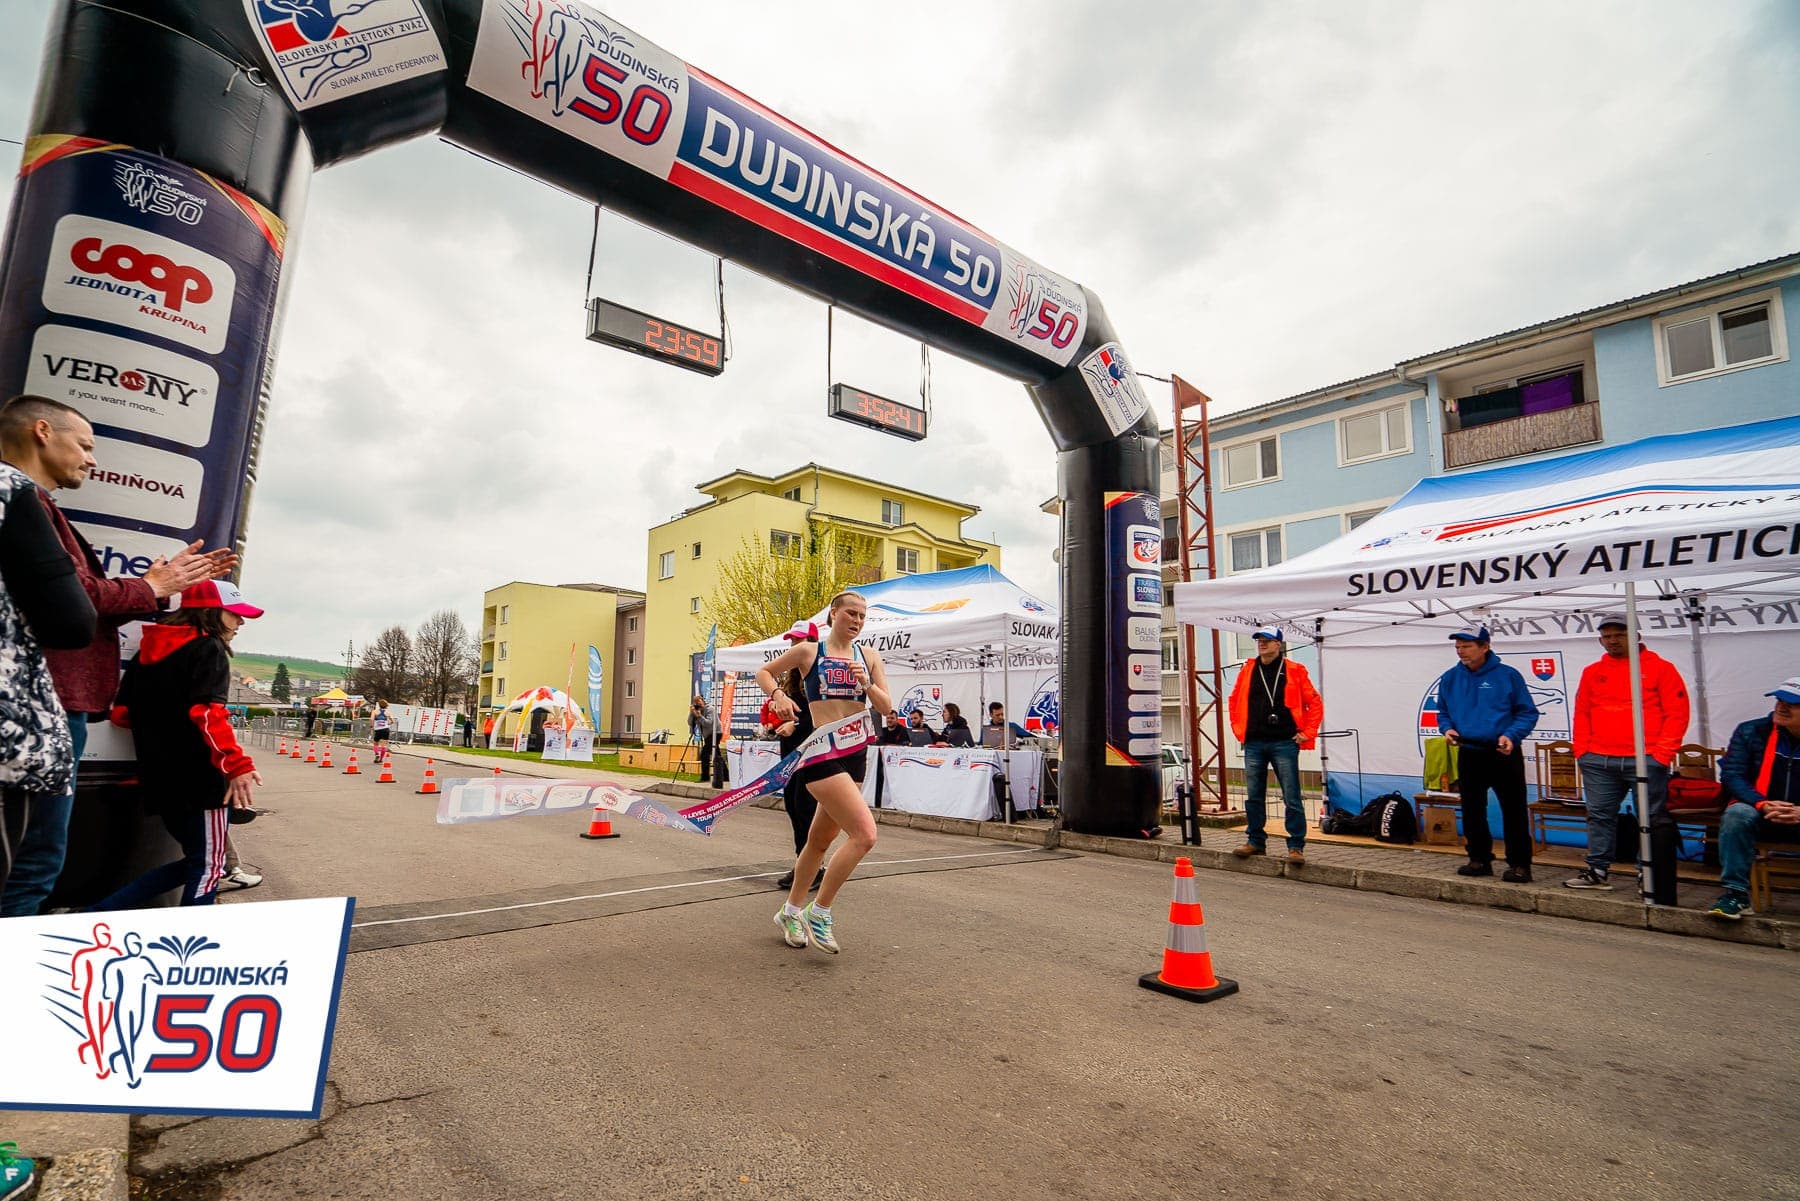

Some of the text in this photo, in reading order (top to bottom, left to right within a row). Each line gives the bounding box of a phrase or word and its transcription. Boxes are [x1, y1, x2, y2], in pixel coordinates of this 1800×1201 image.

[330, 53, 440, 90] SLOVAK ATHLETIC FEDERATION
[597, 40, 679, 94] DUDINSKÁ
[567, 53, 672, 146] 50
[147, 189, 204, 225] 50
[699, 106, 996, 298] DUDINSKÁ 50
[64, 275, 158, 304] JEDNOTA
[138, 305, 207, 334] KRUPINA
[1026, 298, 1079, 349] 50
[644, 319, 719, 366] 23:59
[68, 388, 76, 396] if
[77, 391, 98, 402] you
[100, 394, 126, 407] want
[856, 393, 923, 433] 3:52:41
[89, 468, 185, 499] HRIŇOVÁ
[1347, 542, 1570, 597] SLOVENSKÝ
[878, 630, 911, 652] ZVÄZ
[1011, 621, 1055, 640] SLOVAK
[825, 668, 858, 685] 190
[628, 755, 633, 765] 2
[1381, 800, 1398, 837] adidas
